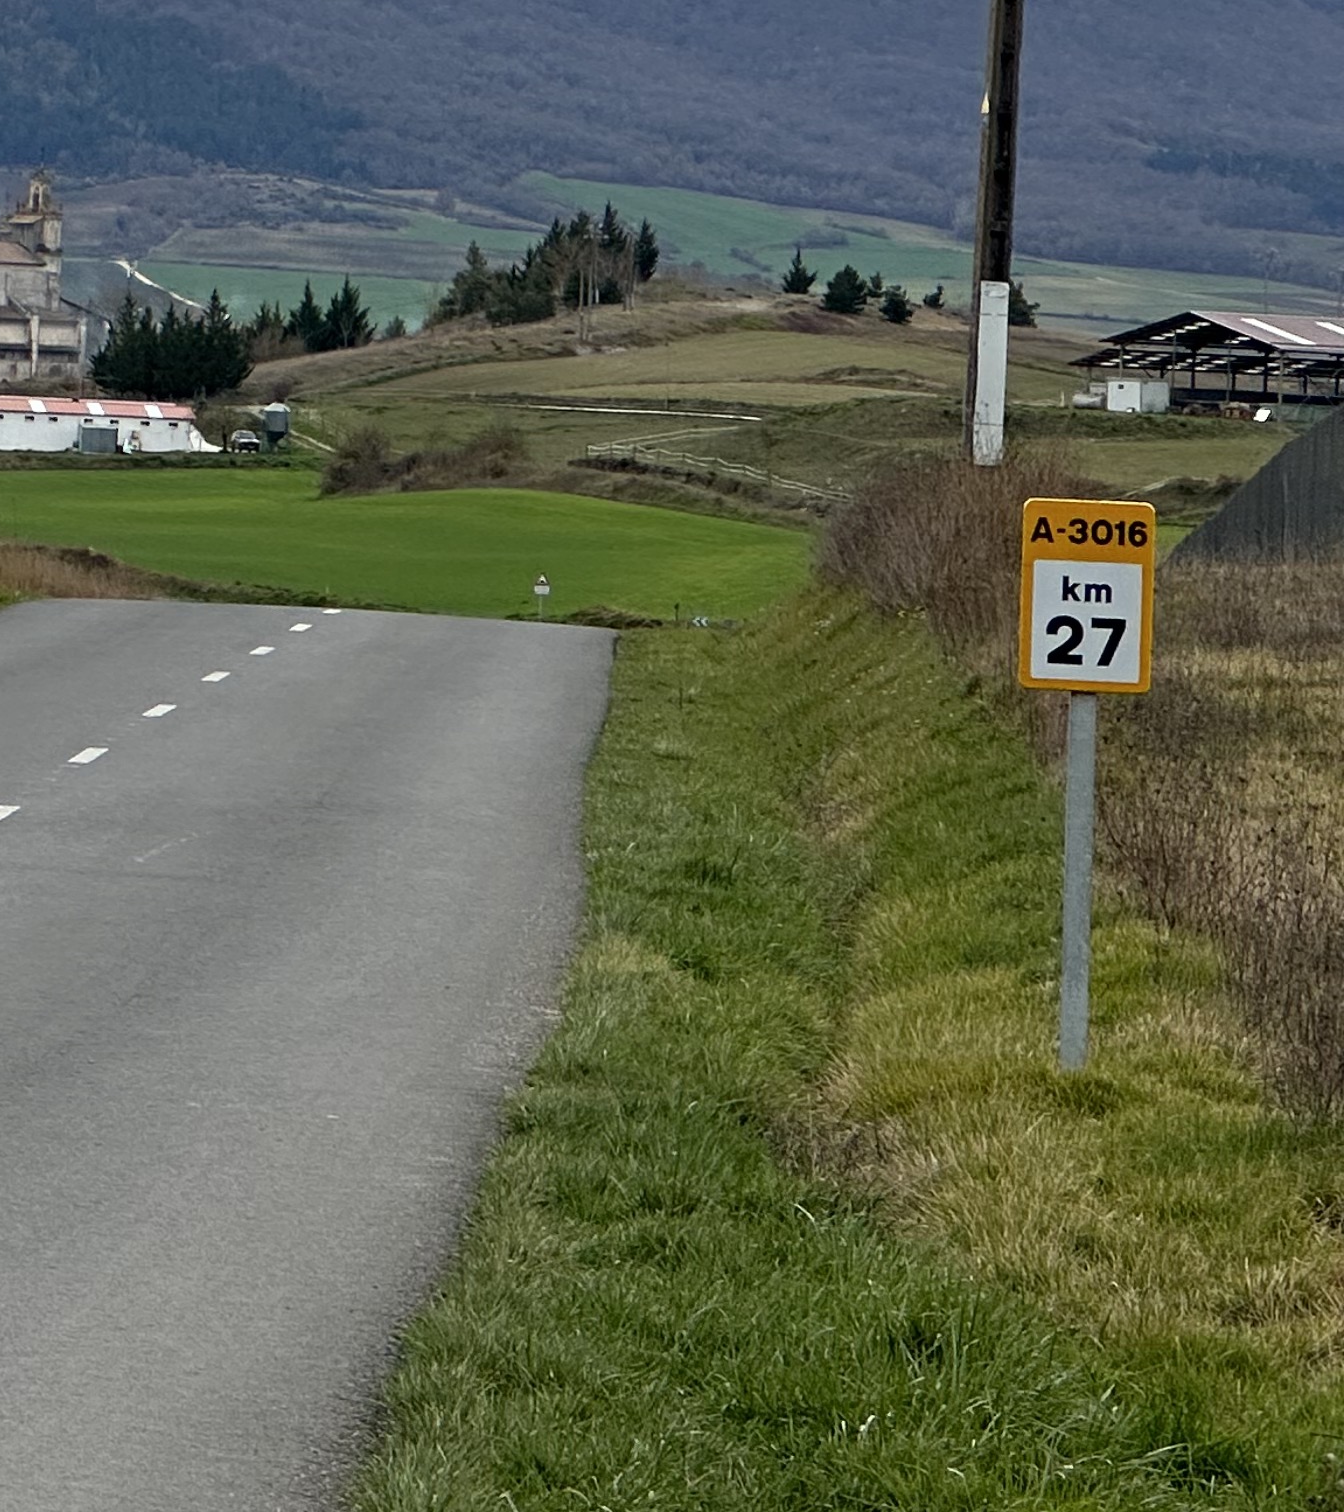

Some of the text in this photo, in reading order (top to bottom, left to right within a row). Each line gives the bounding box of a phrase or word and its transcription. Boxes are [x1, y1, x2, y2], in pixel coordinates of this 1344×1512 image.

[1031, 517, 1148, 547] A-3016
[1062, 576, 1112, 604] km
[1046, 615, 1127, 667] 27
